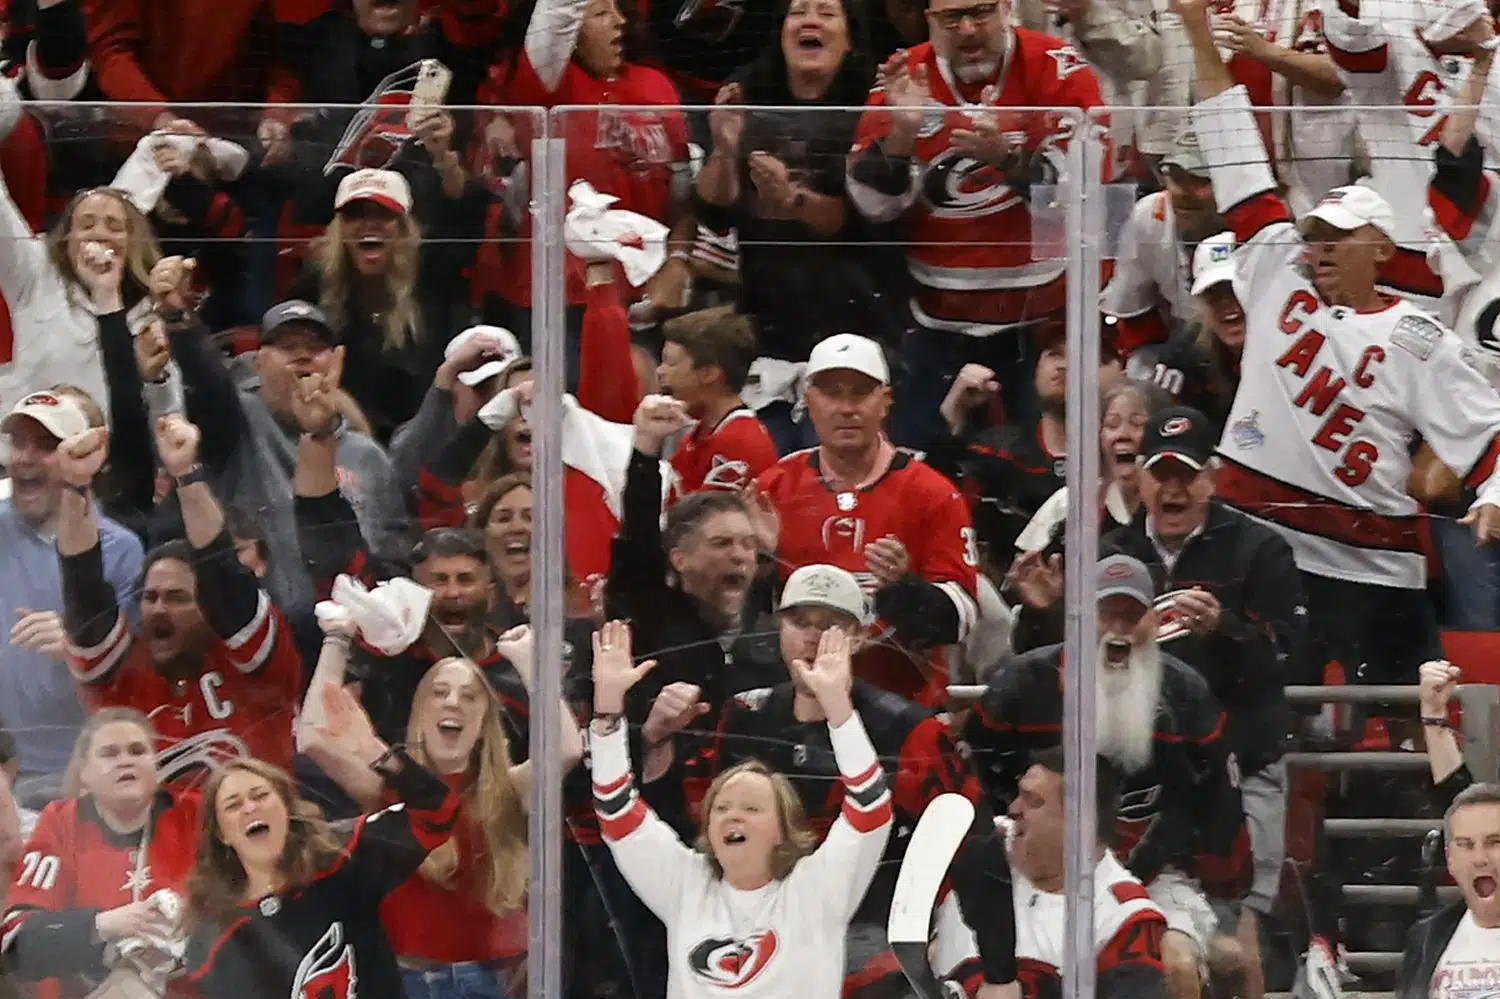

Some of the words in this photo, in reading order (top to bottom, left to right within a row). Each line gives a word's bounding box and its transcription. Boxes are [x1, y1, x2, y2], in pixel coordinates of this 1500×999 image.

[1275, 289, 1379, 488] CANES
[1354, 344, 1387, 389] C
[200, 671, 235, 720] C
